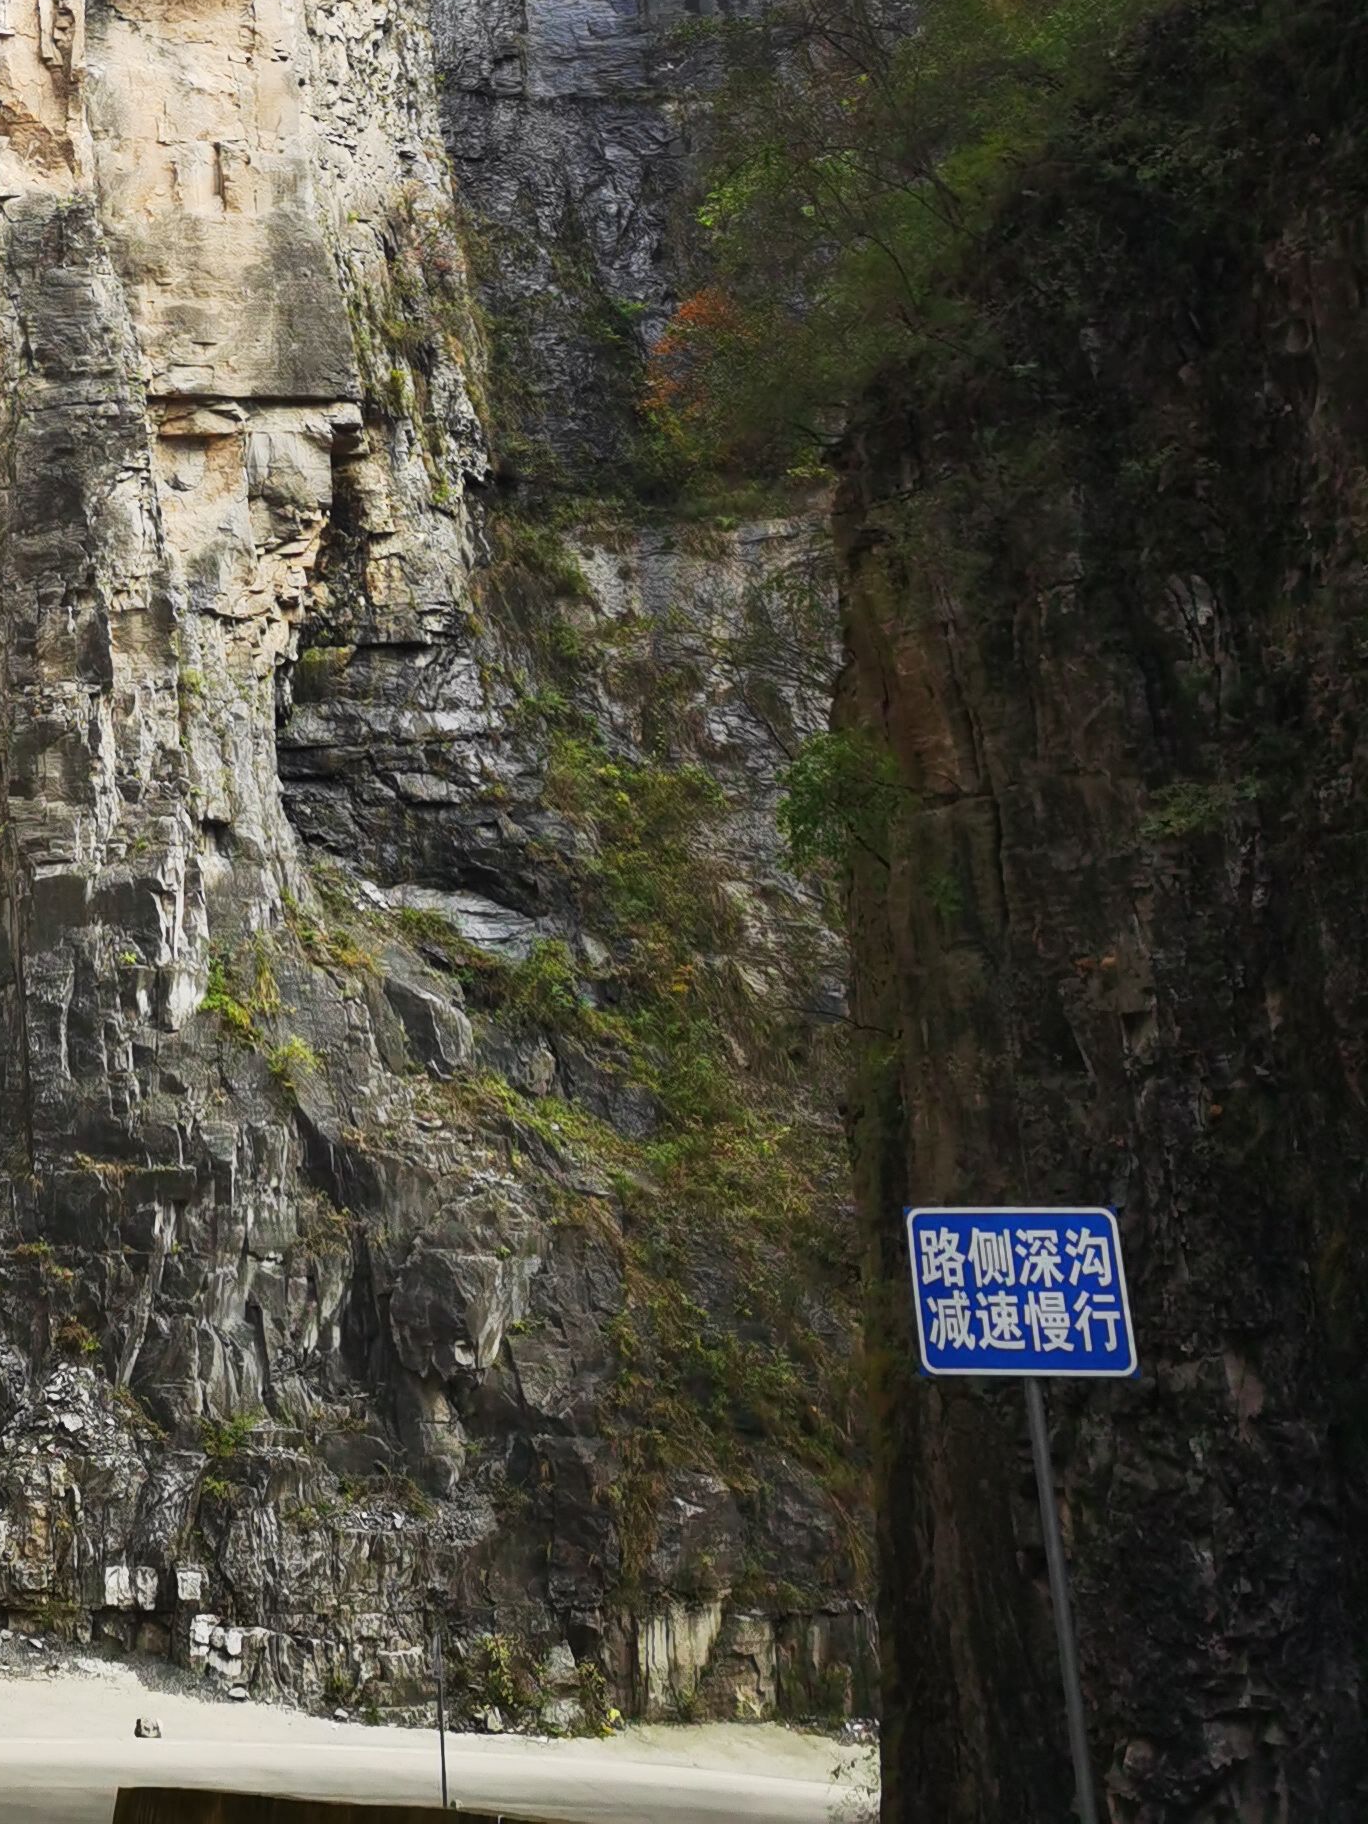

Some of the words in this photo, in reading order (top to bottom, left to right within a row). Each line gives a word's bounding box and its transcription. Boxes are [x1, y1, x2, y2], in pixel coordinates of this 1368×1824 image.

[919, 1226, 1113, 1287] 路侧深沟
[926, 1289, 1120, 1352] 减速慢行
